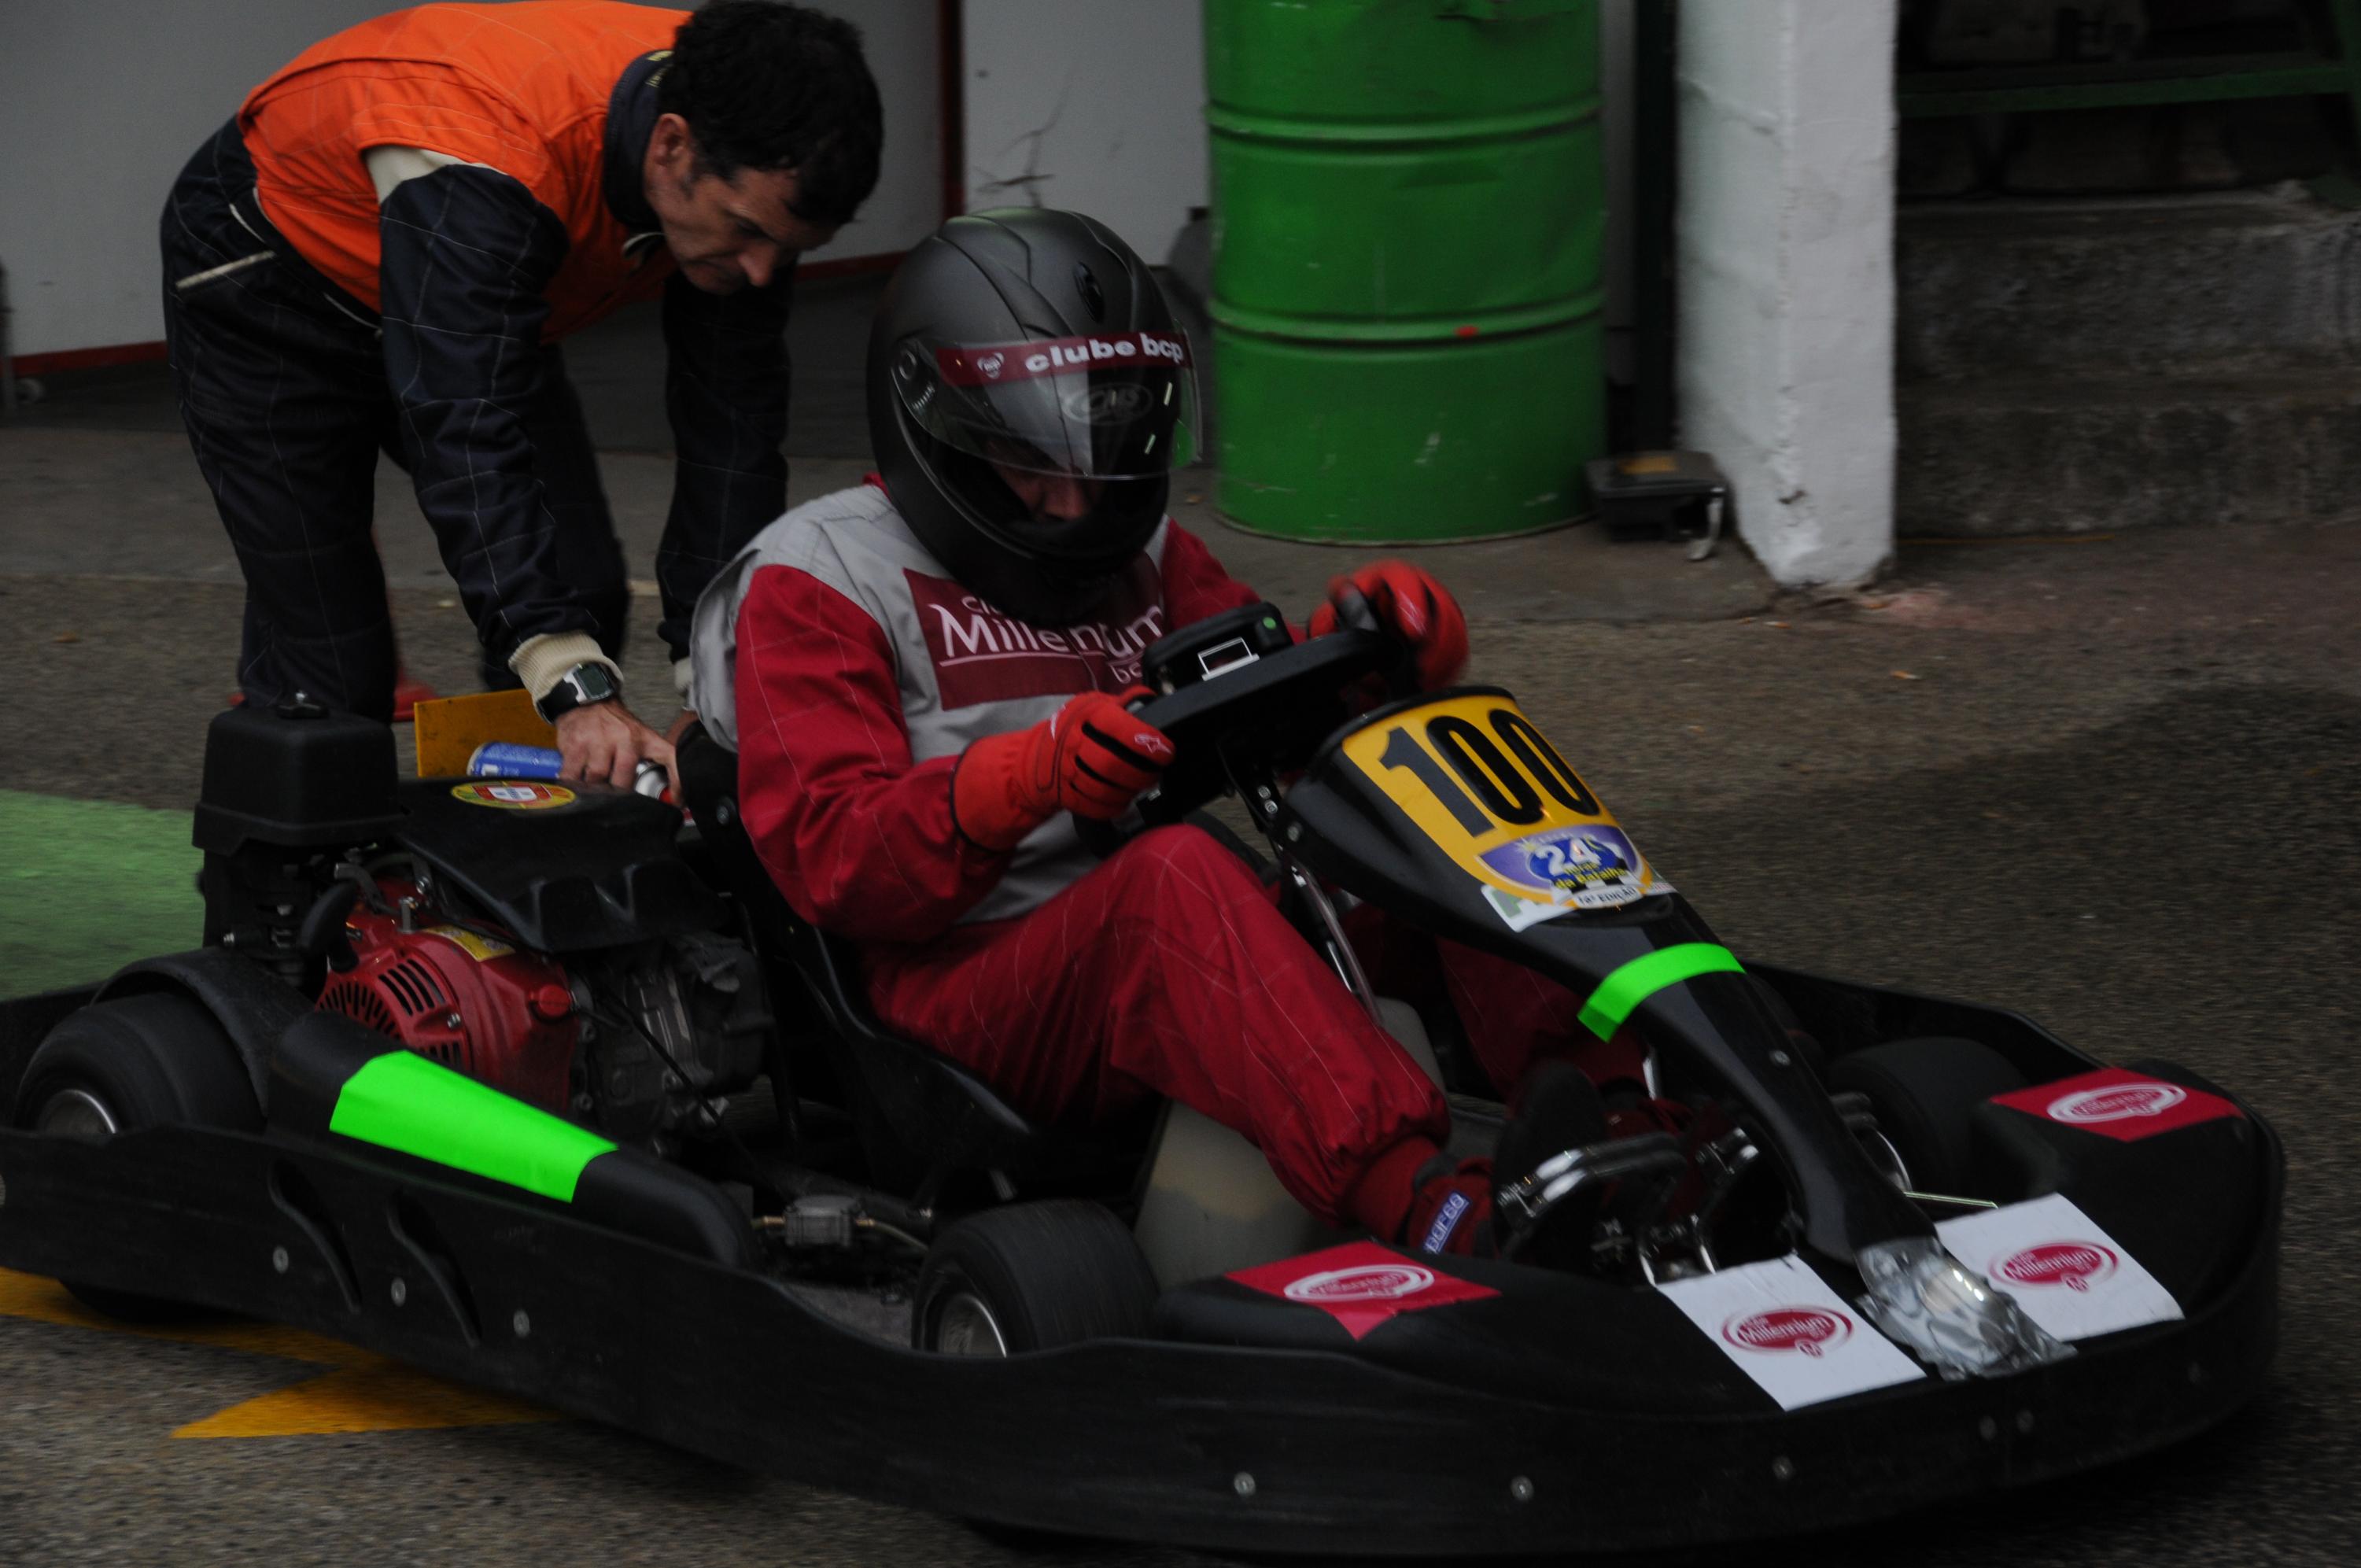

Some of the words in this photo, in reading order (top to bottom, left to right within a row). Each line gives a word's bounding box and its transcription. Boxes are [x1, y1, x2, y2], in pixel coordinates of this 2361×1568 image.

[1025, 338, 1137, 374] clube
[1139, 332, 1184, 365] bcp
[1107, 662, 1143, 684] bc
[1379, 710, 1599, 838] 100
[1533, 837, 1602, 877] 24
[2004, 1251, 2099, 1280] Millennium
[1737, 1316, 1832, 1346] Millennium
